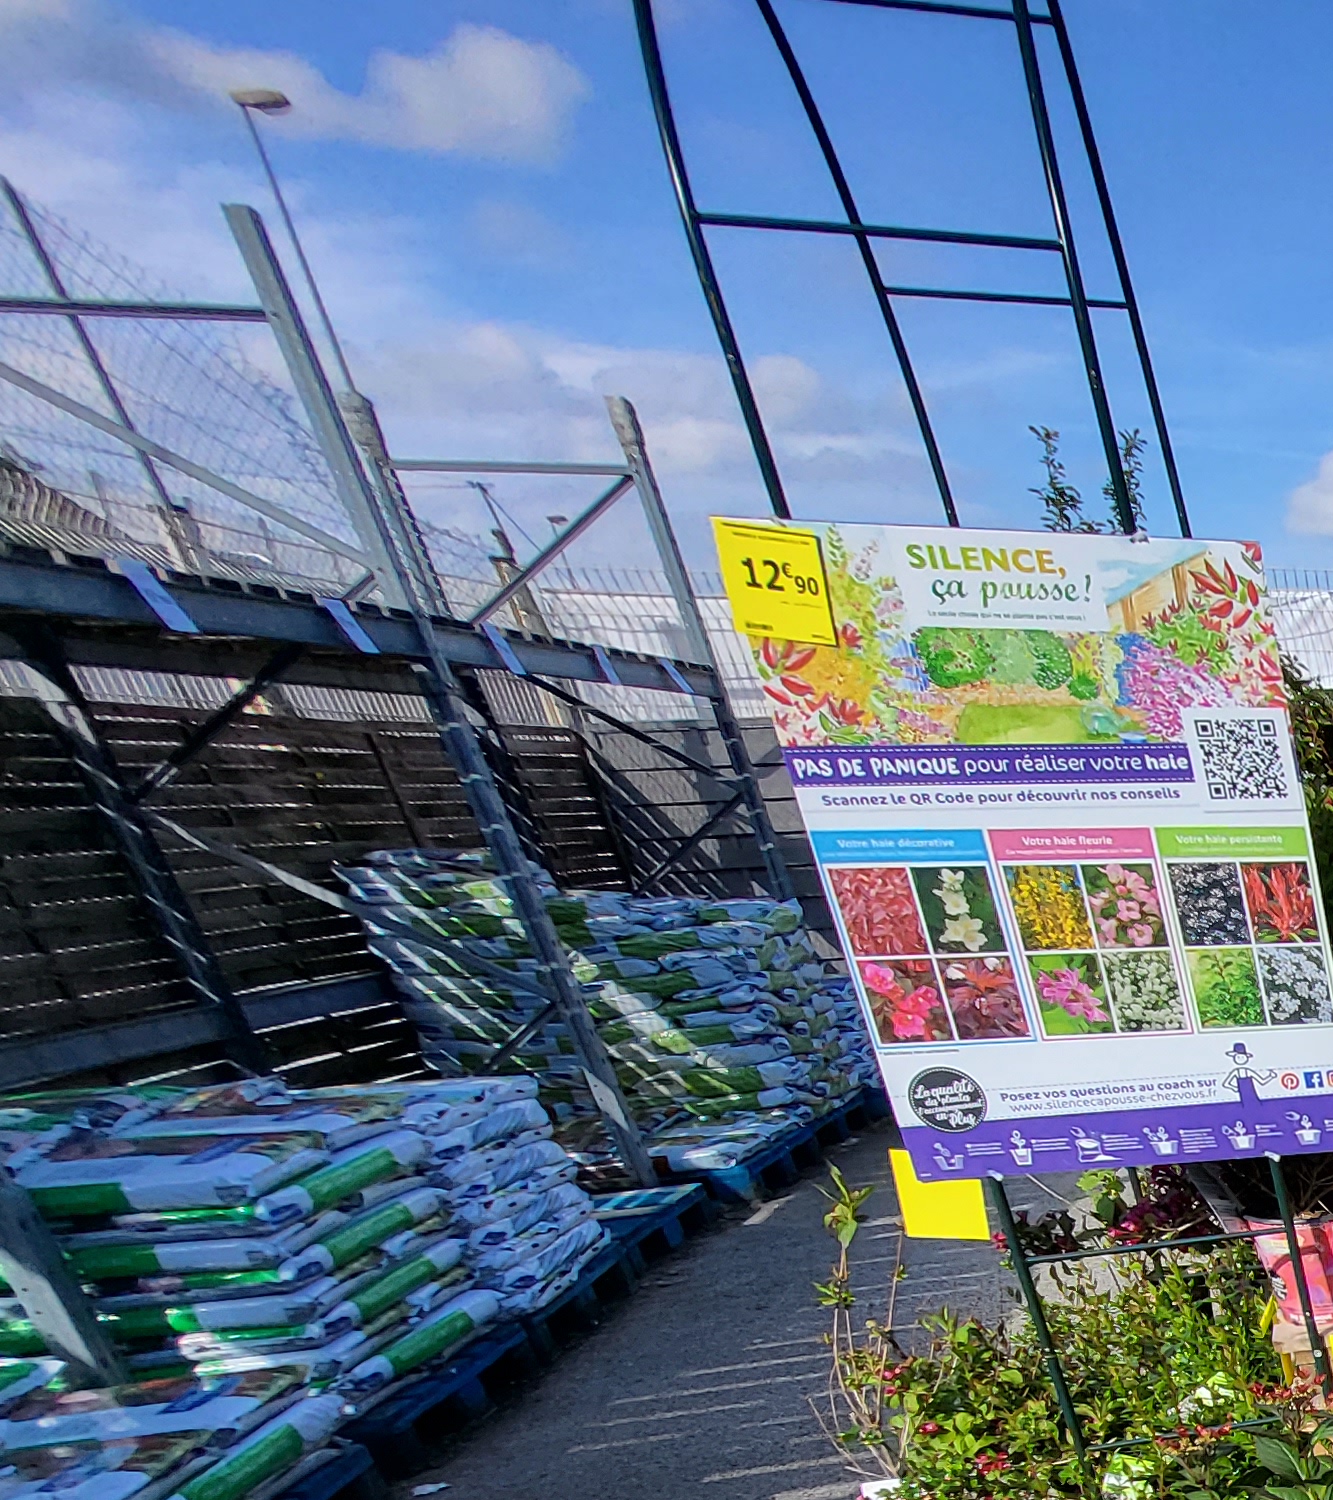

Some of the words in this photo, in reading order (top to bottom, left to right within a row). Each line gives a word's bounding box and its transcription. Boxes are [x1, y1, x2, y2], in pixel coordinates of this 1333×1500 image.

[905, 543, 1067, 580] SILENCE,
[931, 578, 968, 605] ça
[792, 757, 833, 780] PAS
[837, 757, 867, 778] DE
[869, 757, 961, 779] PANIQUE
[964, 756, 1009, 777] pour
[1014, 754, 1086, 773] réaliser
[1089, 753, 1143, 772] votre
[1145, 752, 1190, 771] haie
[821, 793, 888, 807] Scannez
[890, 792, 906, 806] le
[910, 792, 933, 807] QR
[934, 791, 975, 805] Code
[978, 793, 1013, 806] pour
[1015, 788, 1087, 803] découvrir
[1090, 790, 1118, 802] nos
[1120, 787, 1182, 800] conseils
[836, 839, 869, 849] Votre
[872, 838, 896, 848] haie
[1021, 836, 1052, 847] Votre
[1053, 836, 1077, 846] haie
[1078, 835, 1113, 846] fleurie
[1175, 834, 1203, 844] Votre
[1205, 833, 1227, 843] haie
[1000, 1092, 1042, 1103] Posez
[1042, 1090, 1067, 1100] vos
[1070, 1084, 1136, 1099] questions
[1138, 1083, 1155, 1092] au
[1157, 1079, 1195, 1091] coach
[1196, 1078, 1218, 1088] sur
[1009, 1088, 1218, 1113] www.silencecapousse-chezvous.fr
